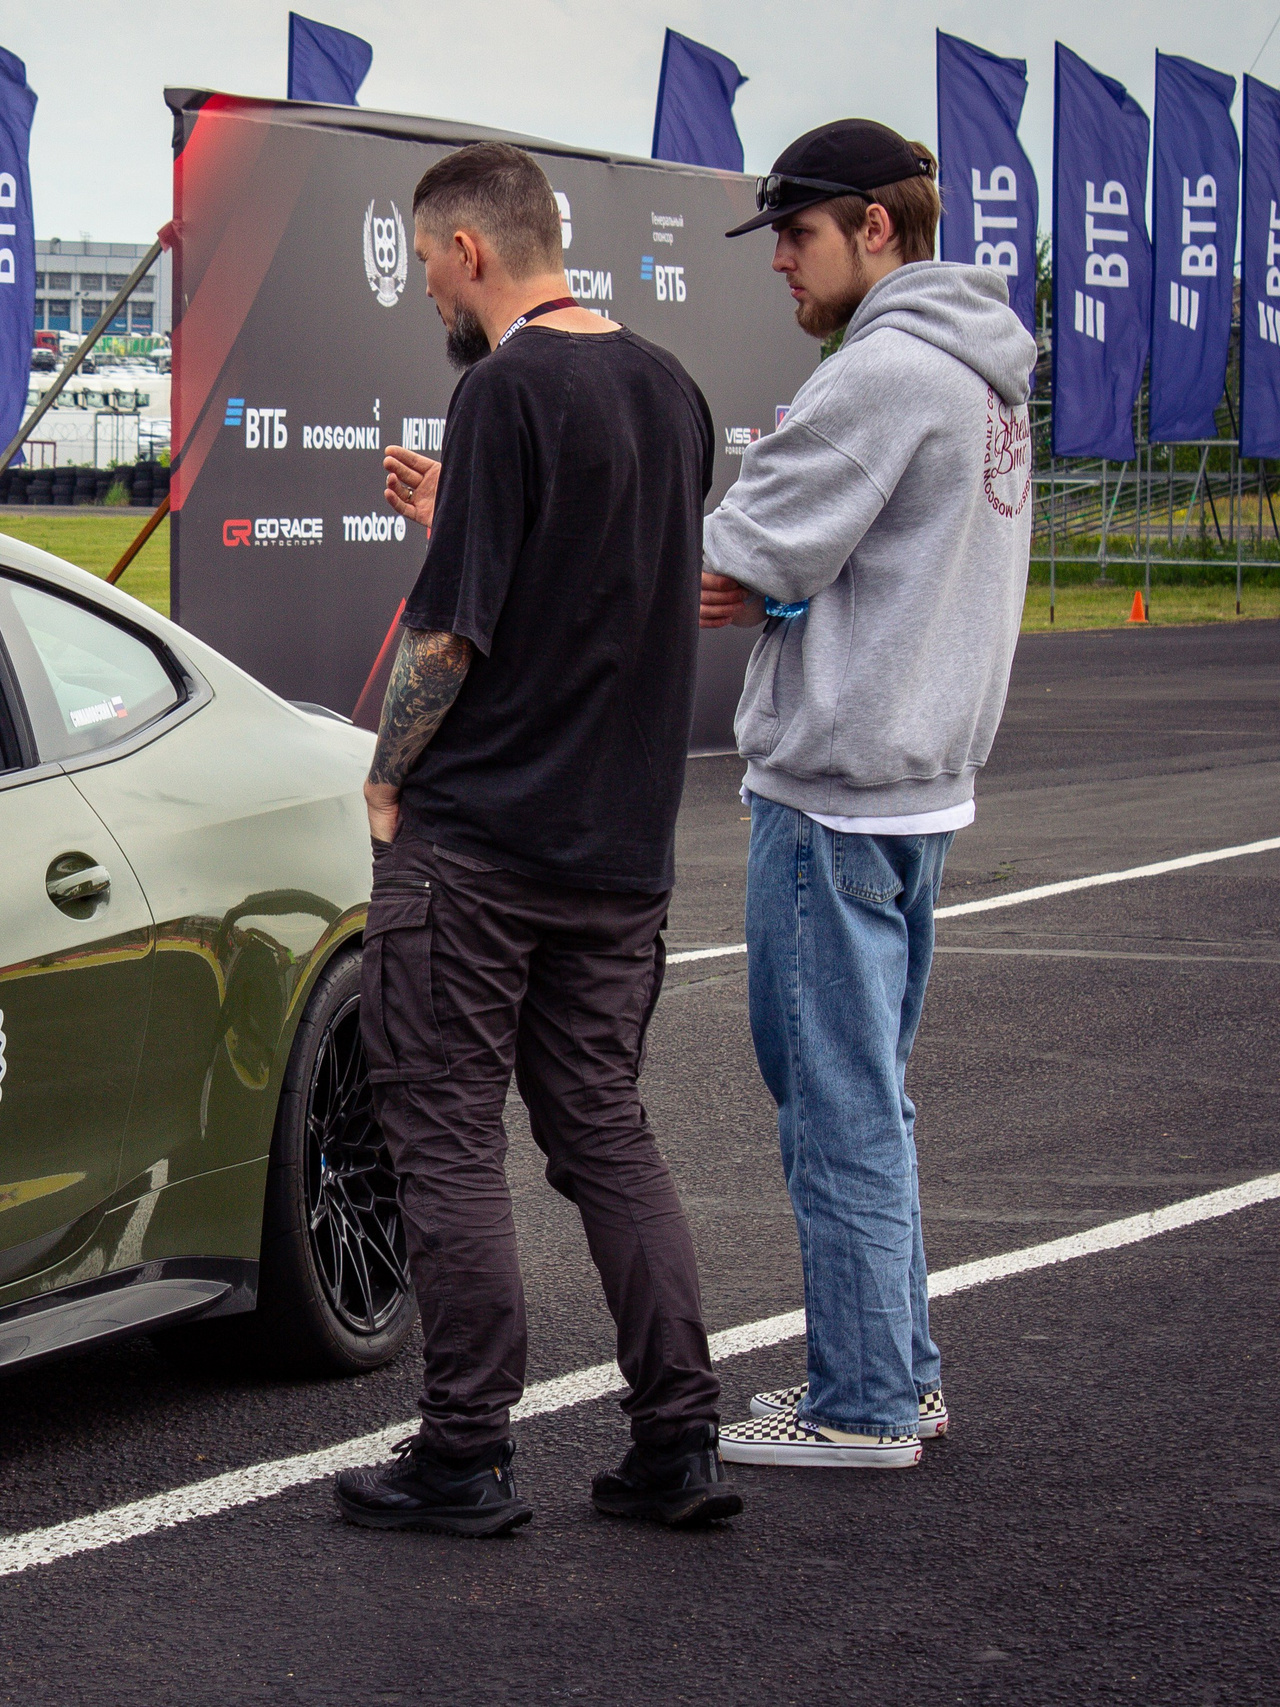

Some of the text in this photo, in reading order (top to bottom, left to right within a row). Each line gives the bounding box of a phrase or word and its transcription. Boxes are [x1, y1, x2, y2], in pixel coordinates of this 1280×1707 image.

[972, 165, 1018, 277] ВТБ
[1085, 180, 1129, 288] ВТБ
[1181, 174, 1217, 277] ВТБ
[655, 265, 686, 302] ВТБ
[245, 408, 288, 449] ВТБ
[302, 425, 380, 450] ROSGONKI
[983, 414, 994, 464] DAILY
[983, 468, 1013, 519] MOSCOW
